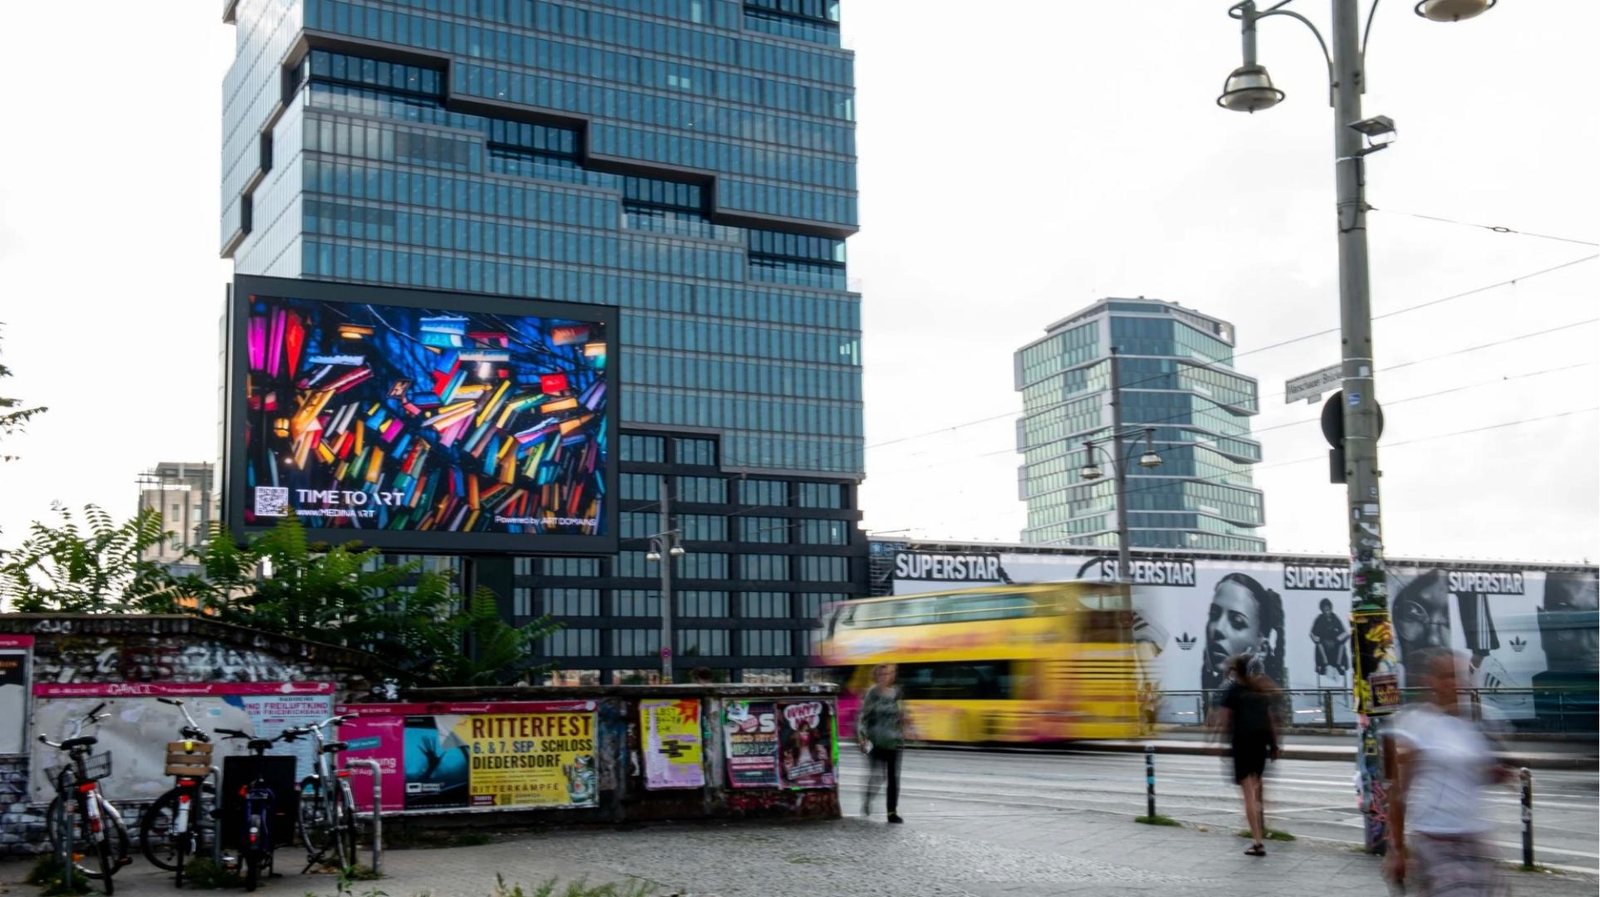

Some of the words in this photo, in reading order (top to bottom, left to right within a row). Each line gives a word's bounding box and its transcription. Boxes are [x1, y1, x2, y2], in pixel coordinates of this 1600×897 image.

[296, 489, 339, 504] TIME
[341, 491, 367, 505] TO
[372, 492, 405, 506] ART
[494, 515, 529, 524] Powered
[530, 516, 540, 526] by
[541, 517, 558, 525] ART
[558, 518, 597, 526] DOMAINS
[895, 553, 1000, 580] SUPERSTAR
[1449, 571, 1523, 593] SUPERSTAR
[472, 716, 592, 738] RITTERFEST
[473, 741, 484, 754] 6.
[488, 741, 496, 753] &
[499, 740, 509, 753] 7.
[512, 740, 538, 752] SEP.
[541, 738, 593, 752] SCHLOSS
[472, 754, 560, 769] DIEDERSDORF
